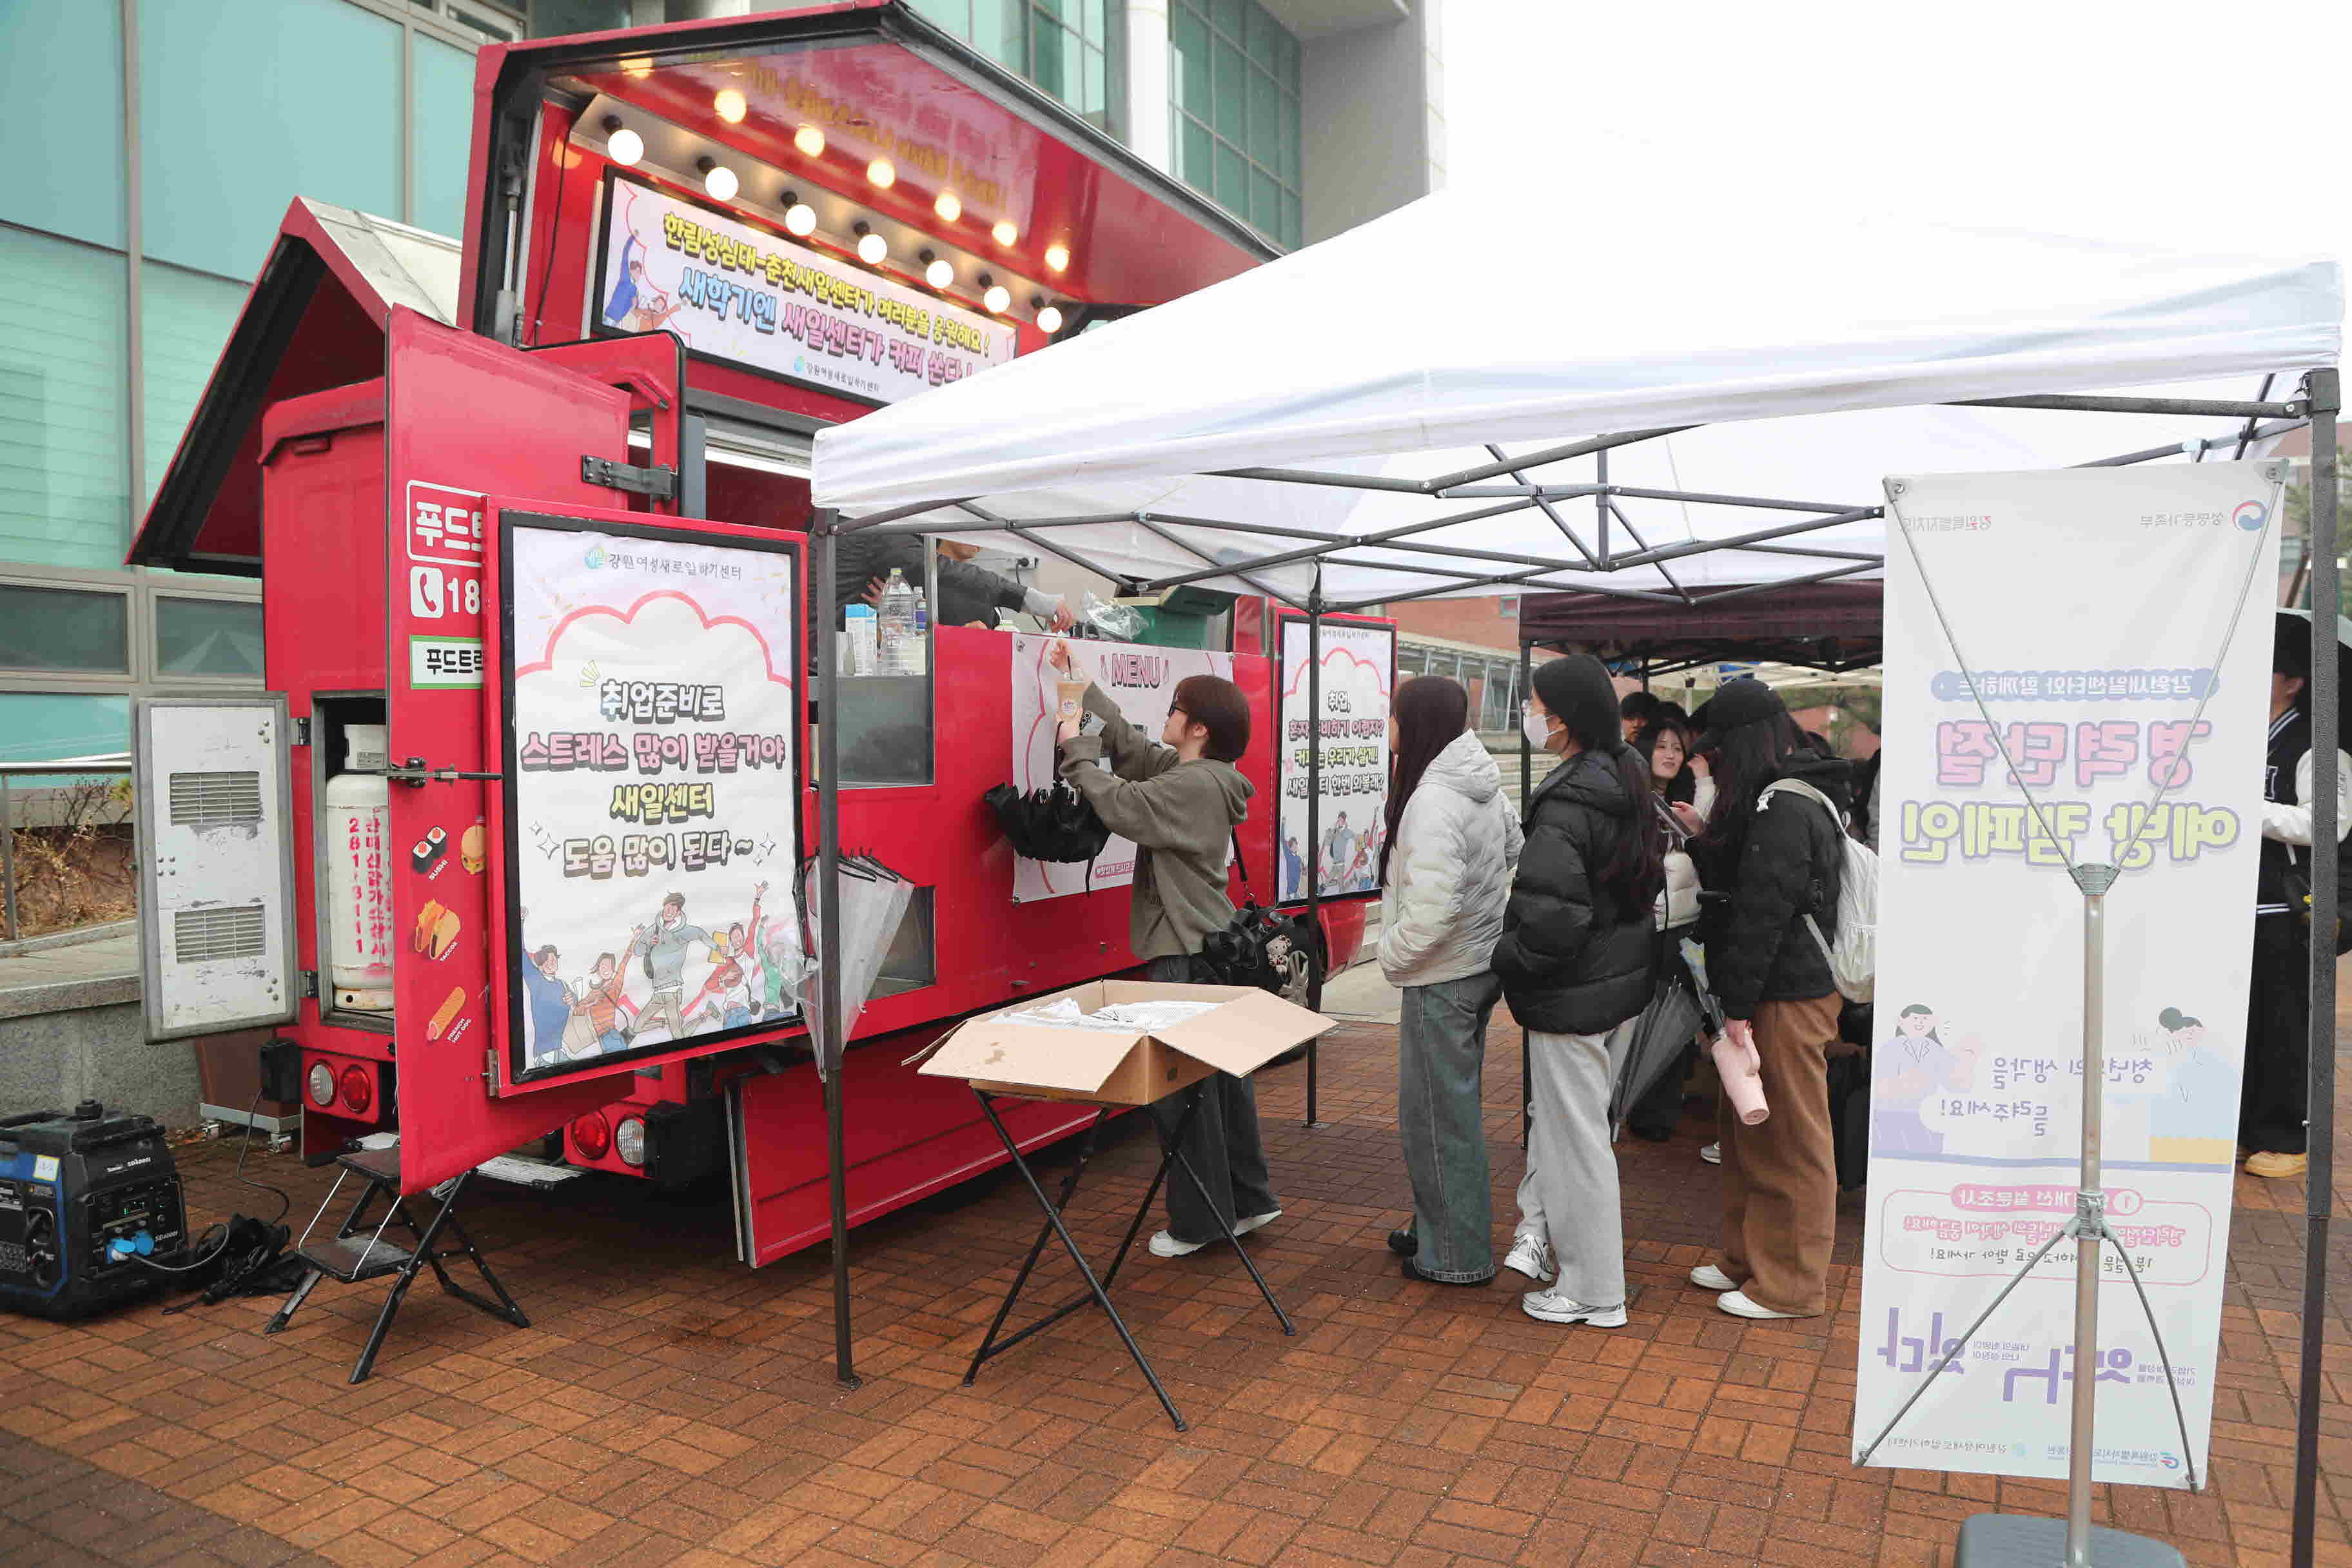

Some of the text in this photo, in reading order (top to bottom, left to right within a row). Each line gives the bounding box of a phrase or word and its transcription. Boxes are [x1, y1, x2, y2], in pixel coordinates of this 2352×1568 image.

[663, 211, 875, 317] 한림성심대-춘천새일센터가
[877, 299, 930, 340] 여러분을
[678, 266, 777, 333] 새학기엔
[780, 303, 885, 366] 새일센터가
[888, 338, 925, 378] 커피
[1112, 652, 1161, 689] MENU
[600, 678, 726, 725] 취업준비로
[1318, 718, 1350, 740] 비하기
[520, 731, 785, 775] 스트레스 많이 받을거야
[1328, 746, 1357, 768] 우리가
[609, 782, 714, 825] 새일센터
[1286, 776, 1329, 799] 새일터
[1331, 774, 1351, 796] 한번
[428, 859, 449, 882] SUSHI
[563, 835, 616, 880] 도움
[622, 833, 676, 877] 많이
